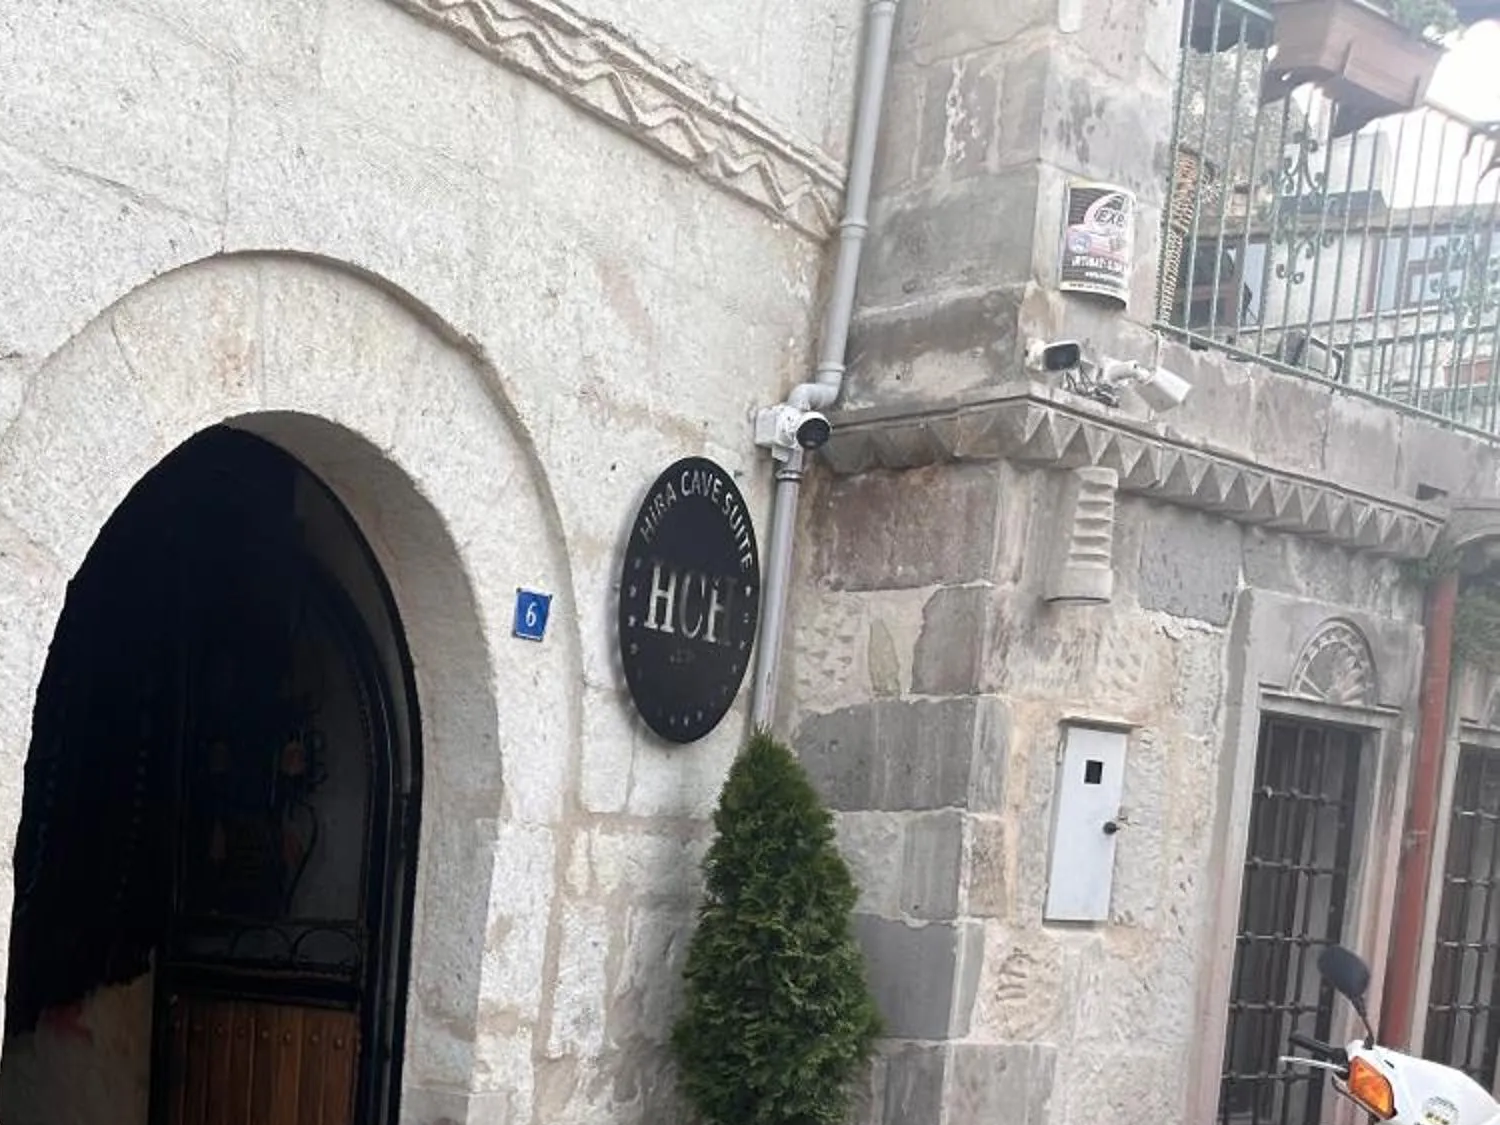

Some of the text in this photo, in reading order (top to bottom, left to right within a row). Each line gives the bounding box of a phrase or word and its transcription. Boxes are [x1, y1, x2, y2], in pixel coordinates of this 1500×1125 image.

[681, 469, 723, 504] CAVE
[722, 491, 753, 573] SUITE
[525, 601, 537, 627] 6
